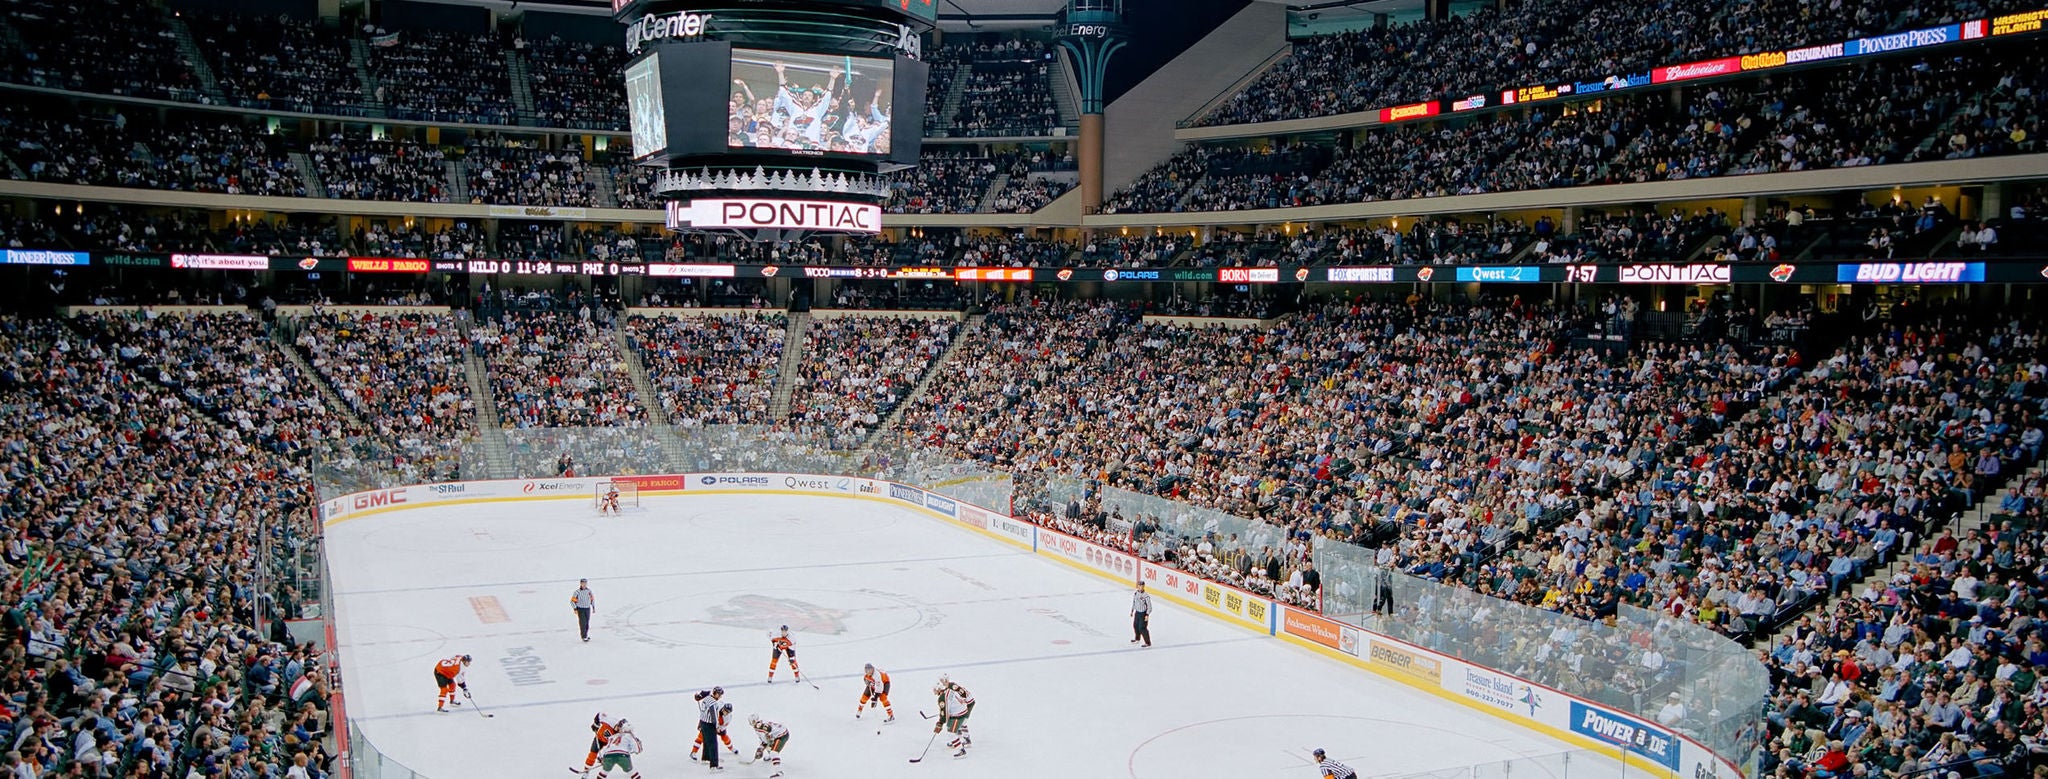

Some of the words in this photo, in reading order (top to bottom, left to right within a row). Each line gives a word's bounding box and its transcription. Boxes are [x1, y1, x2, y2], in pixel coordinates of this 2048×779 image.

[643, 12, 712, 41] Center
[1992, 20, 2041, 35] ATLANTA
[1787, 43, 1843, 63] RESTAURANTE
[1666, 63, 1725, 80] Budweiser
[1575, 81, 1604, 94] Treasure
[1628, 70, 1650, 87] Island
[723, 203, 868, 228] PONTIAC
[104, 254, 160, 265] wild.com
[202, 257, 215, 266] it's
[219, 257, 246, 267] about
[247, 259, 267, 268] you.
[352, 260, 389, 271] WELLS
[393, 261, 428, 271] FARGO
[469, 261, 498, 273] WILD
[502, 262, 511, 273] 0
[517, 262, 552, 274] 11:24
[582, 263, 604, 275] PHI
[610, 263, 619, 275] 0
[1220, 269, 1248, 281] BORN
[1472, 267, 1506, 281] Qwest
[1566, 265, 1597, 282] 7:57
[1620, 265, 1730, 281] PONTIAC
[1857, 263, 1901, 281] BUD
[1902, 263, 1966, 281] LIGHT
[1119, 271, 1159, 280] POLARIS
[1174, 270, 1213, 281] wild.com
[538, 482, 558, 490] Xcel
[559, 482, 584, 492] Energy
[720, 476, 769, 484] POLARIS
[785, 476, 829, 489] Qwest
[354, 489, 408, 510] GMC
[1145, 567, 1157, 581] 3M
[1166, 573, 1178, 588] 3M
[1186, 580, 1198, 596] 3M
[1205, 586, 1220, 599] BEST
[1206, 593, 1219, 605] BUY
[1226, 593, 1242, 606] BEST
[1227, 600, 1240, 612] BUY
[1248, 601, 1264, 614] BEST
[1249, 607, 1264, 619] BUY
[1311, 623, 1338, 641] Windows
[1370, 645, 1411, 668] BERGER
[1465, 667, 1491, 688] Treasure
[1493, 677, 1513, 695] Island
